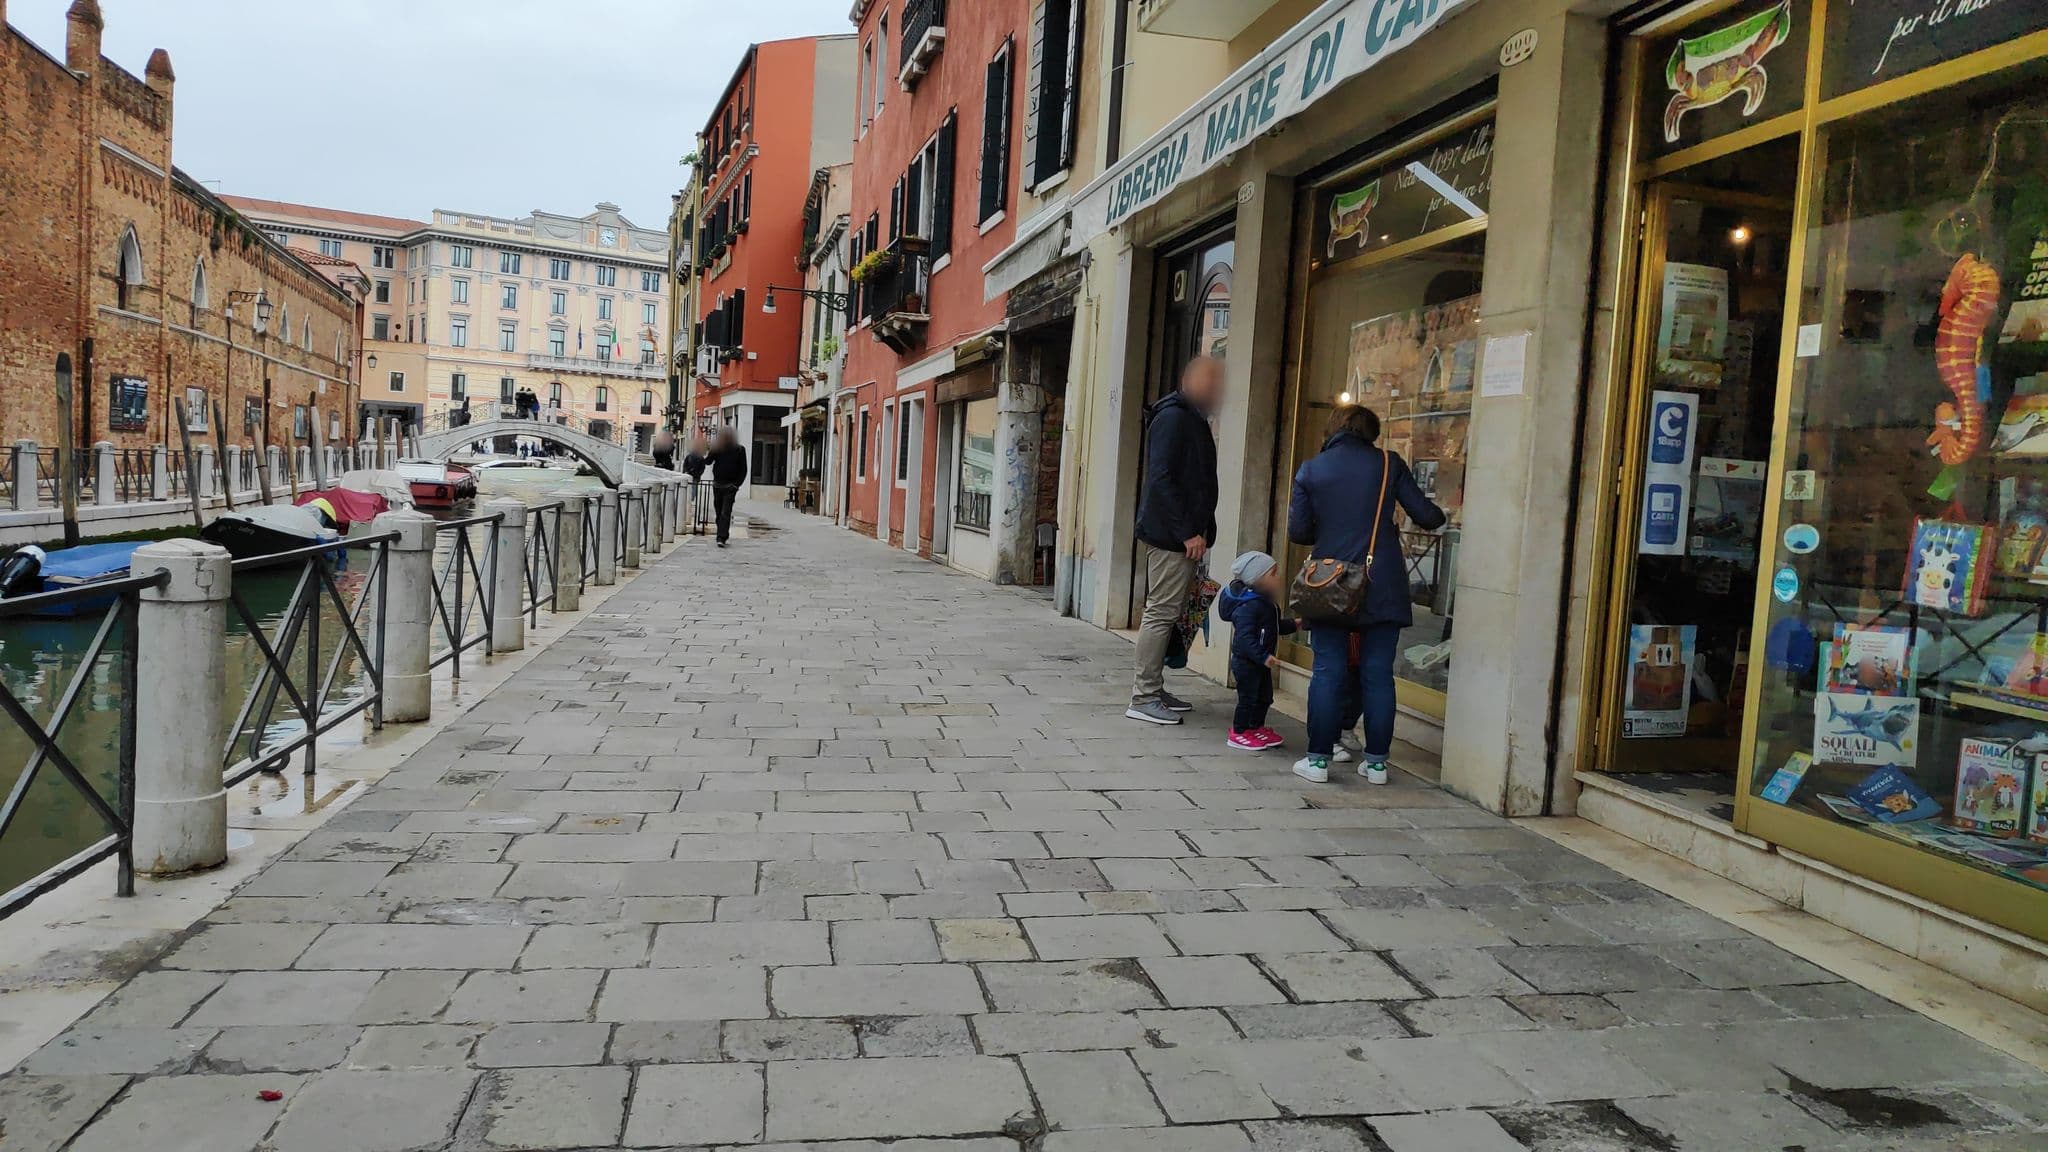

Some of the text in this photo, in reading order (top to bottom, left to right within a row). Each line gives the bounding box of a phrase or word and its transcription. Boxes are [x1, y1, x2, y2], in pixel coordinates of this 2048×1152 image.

[1872, 14, 1924, 75] per
[1106, 0, 1451, 225] LIBRERIA MARE DI CA
[1657, 437, 1681, 448] 18app
[1821, 735, 1877, 753] SQUALI
